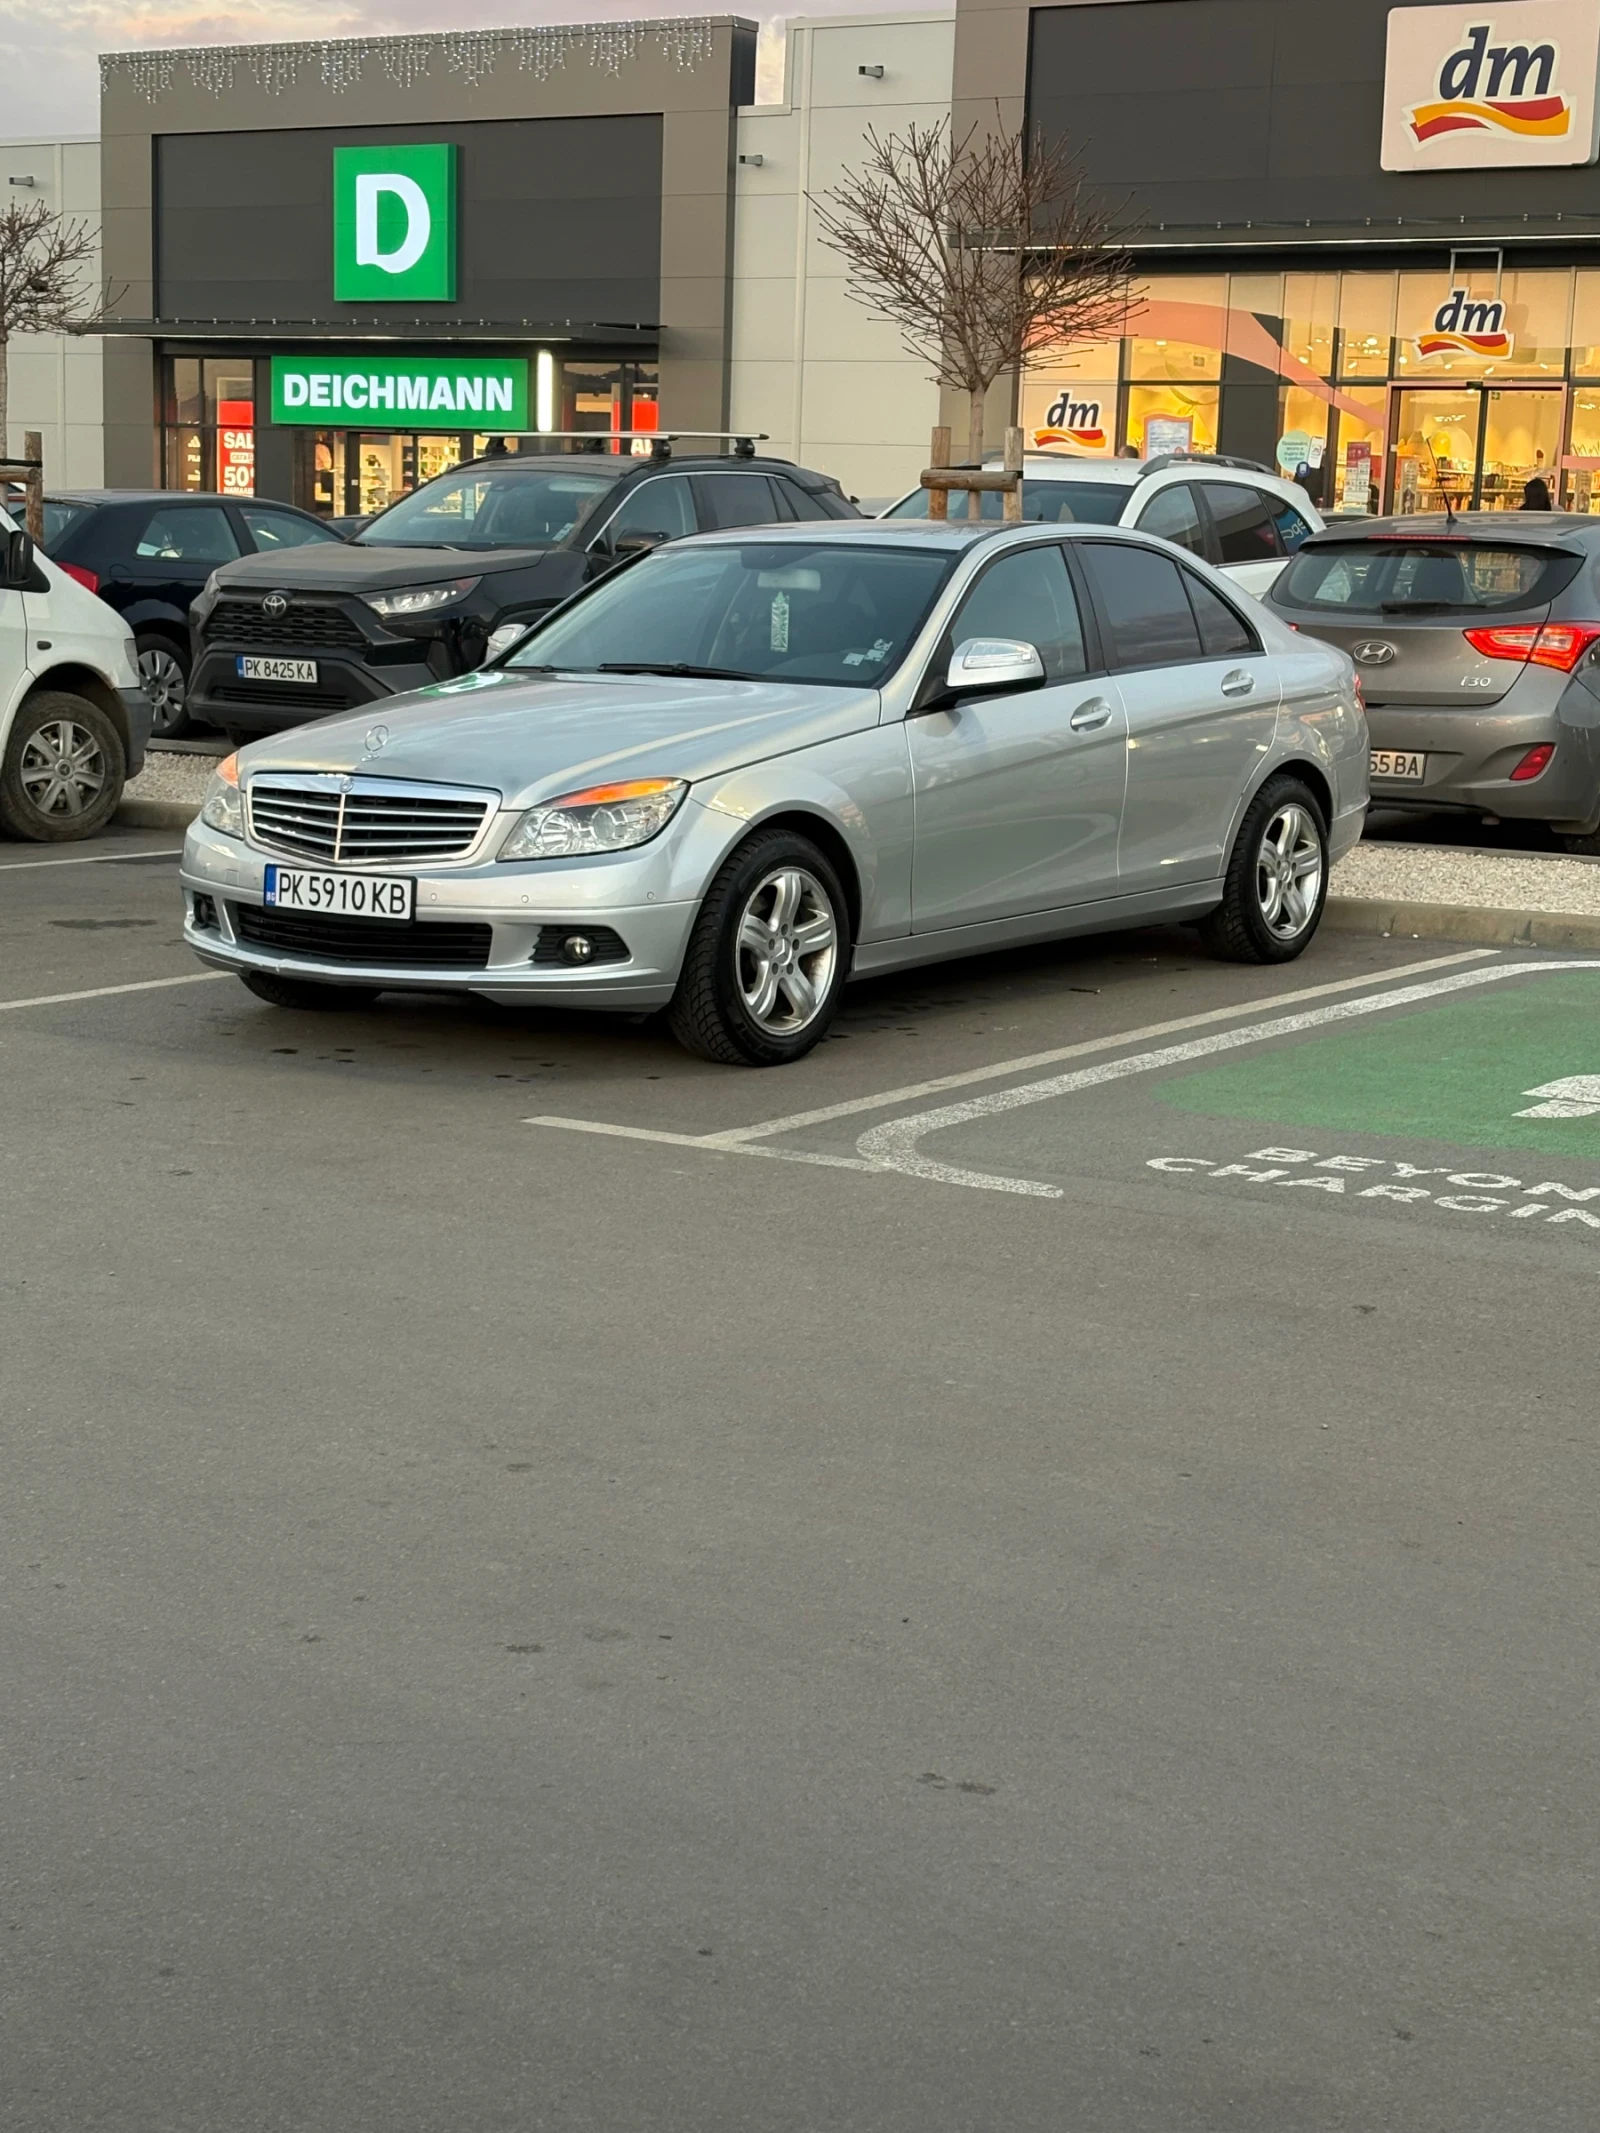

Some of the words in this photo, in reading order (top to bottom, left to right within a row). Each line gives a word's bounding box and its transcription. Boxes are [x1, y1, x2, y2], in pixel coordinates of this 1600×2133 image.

[1440, 26, 1556, 100] dm
[356, 174, 431, 274] D
[1434, 290, 1503, 333] dm
[283, 374, 513, 412] DEICHMANN
[1047, 392, 1100, 428] dm
[244, 659, 261, 677] PK
[264, 660, 295, 679] 8425
[297, 662, 315, 681] KA
[1394, 755, 1419, 777] BA
[279, 873, 304, 906] PK
[309, 876, 366, 911] 5910
[372, 881, 406, 914] KB
